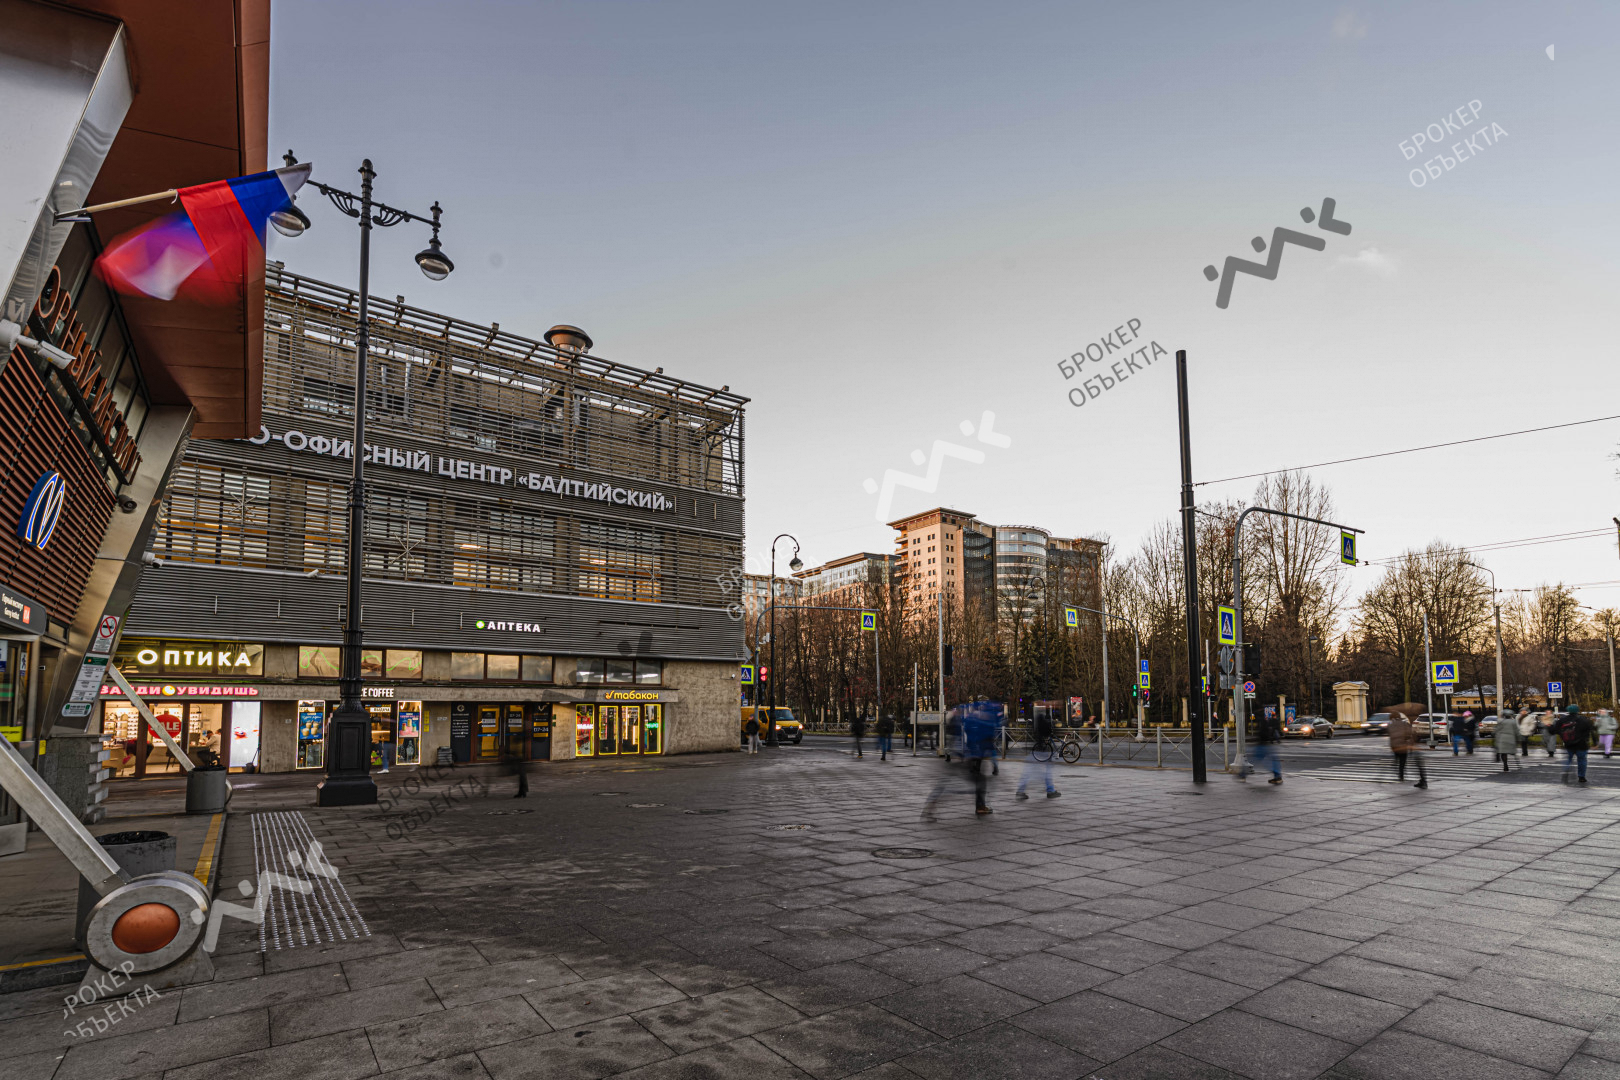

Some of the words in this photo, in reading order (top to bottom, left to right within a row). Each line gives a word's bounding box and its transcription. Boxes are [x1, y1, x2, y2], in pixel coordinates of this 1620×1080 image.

[24, 265, 104, 400] ОРНЫЙ
[234, 425, 430, 473] О-ОФИСНЫЙ
[438, 457, 512, 485] ЦЕНТР
[518, 473, 673, 511] «БАЛТИЙСКИЙ»
[487, 621, 541, 633] АПТЕКА
[137, 649, 252, 667] ОПТИКА
[100, 685, 161, 695] ЗАДИ
[176, 685, 259, 696] УВИДИШЬ
[368, 687, 395, 698] COFFEE
[613, 690, 659, 700] табакон
